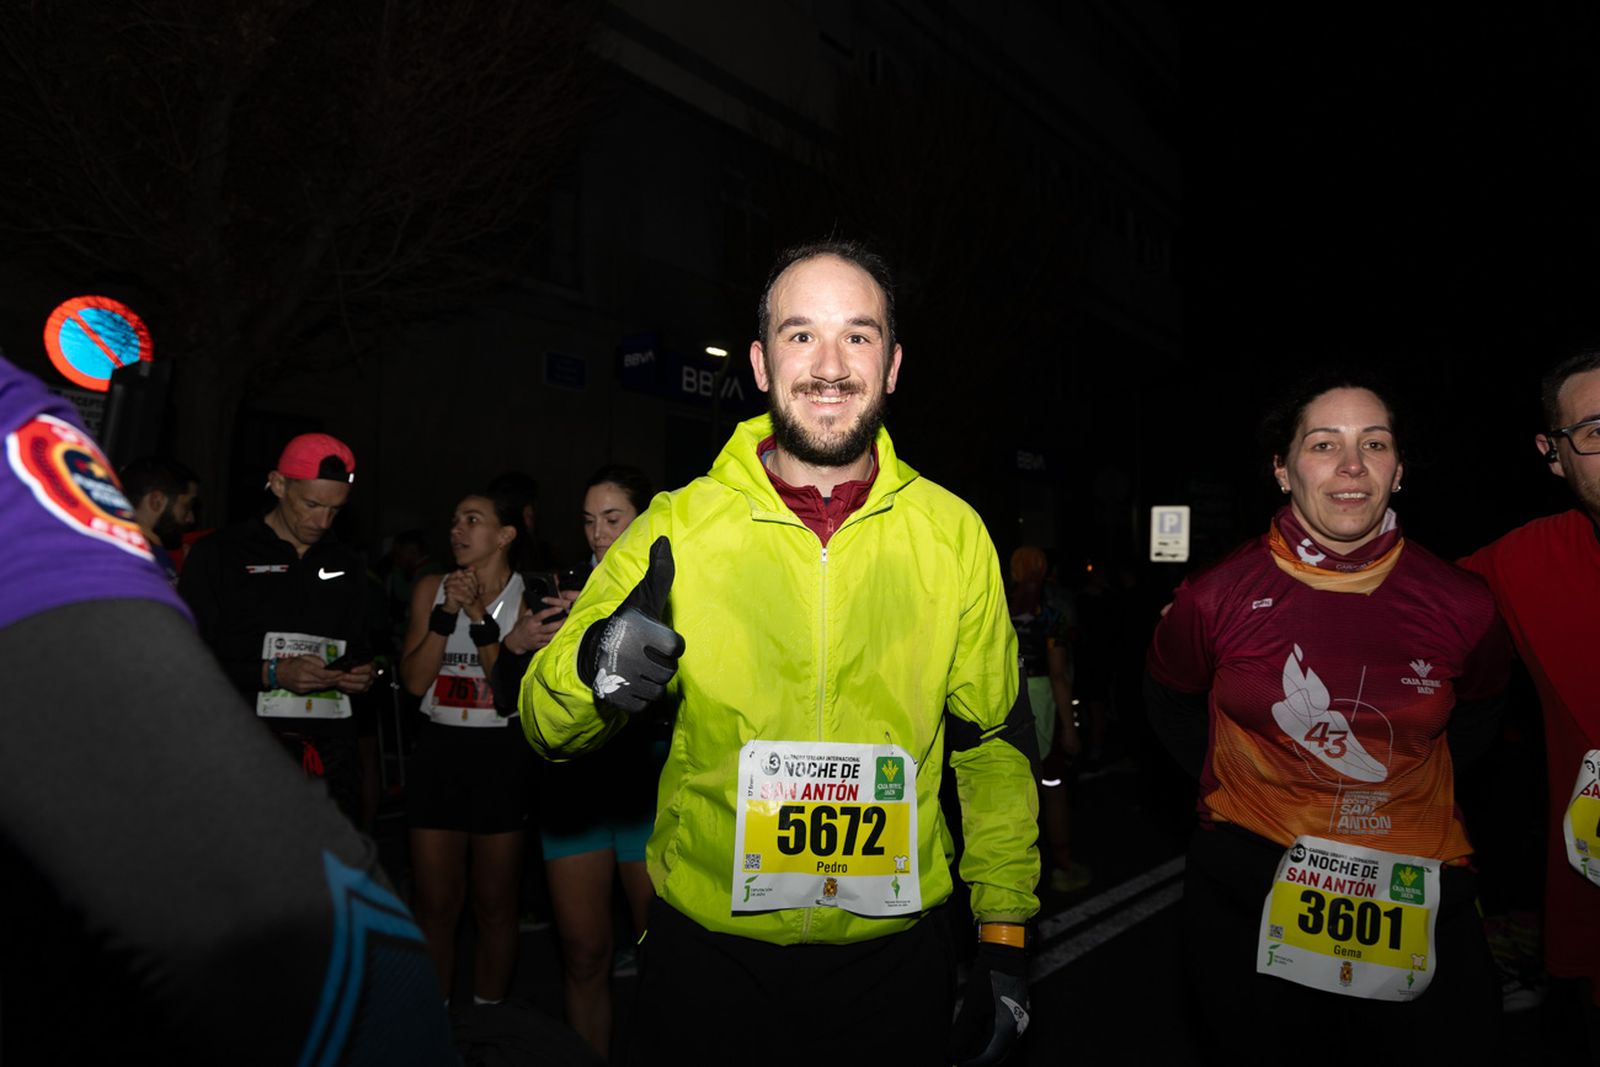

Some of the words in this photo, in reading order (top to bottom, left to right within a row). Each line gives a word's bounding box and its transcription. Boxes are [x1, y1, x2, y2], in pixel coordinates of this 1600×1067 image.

[623, 349, 656, 368] BBVA
[1164, 512, 1179, 532] P
[1304, 722, 1348, 759] 43
[784, 761, 837, 778] NOCHE
[840, 763, 860, 779] DE
[760, 782, 797, 800] SAN
[800, 779, 860, 801] ANTÓN
[777, 805, 887, 857] 5672
[816, 861, 848, 873] Pedro
[1308, 854, 1360, 877] NOCHE
[1361, 864, 1380, 880] DE
[1286, 867, 1321, 887] SAN
[1322, 875, 1377, 898] ANTÓN
[1298, 889, 1404, 951] 3601
[1333, 944, 1363, 959] Gema
